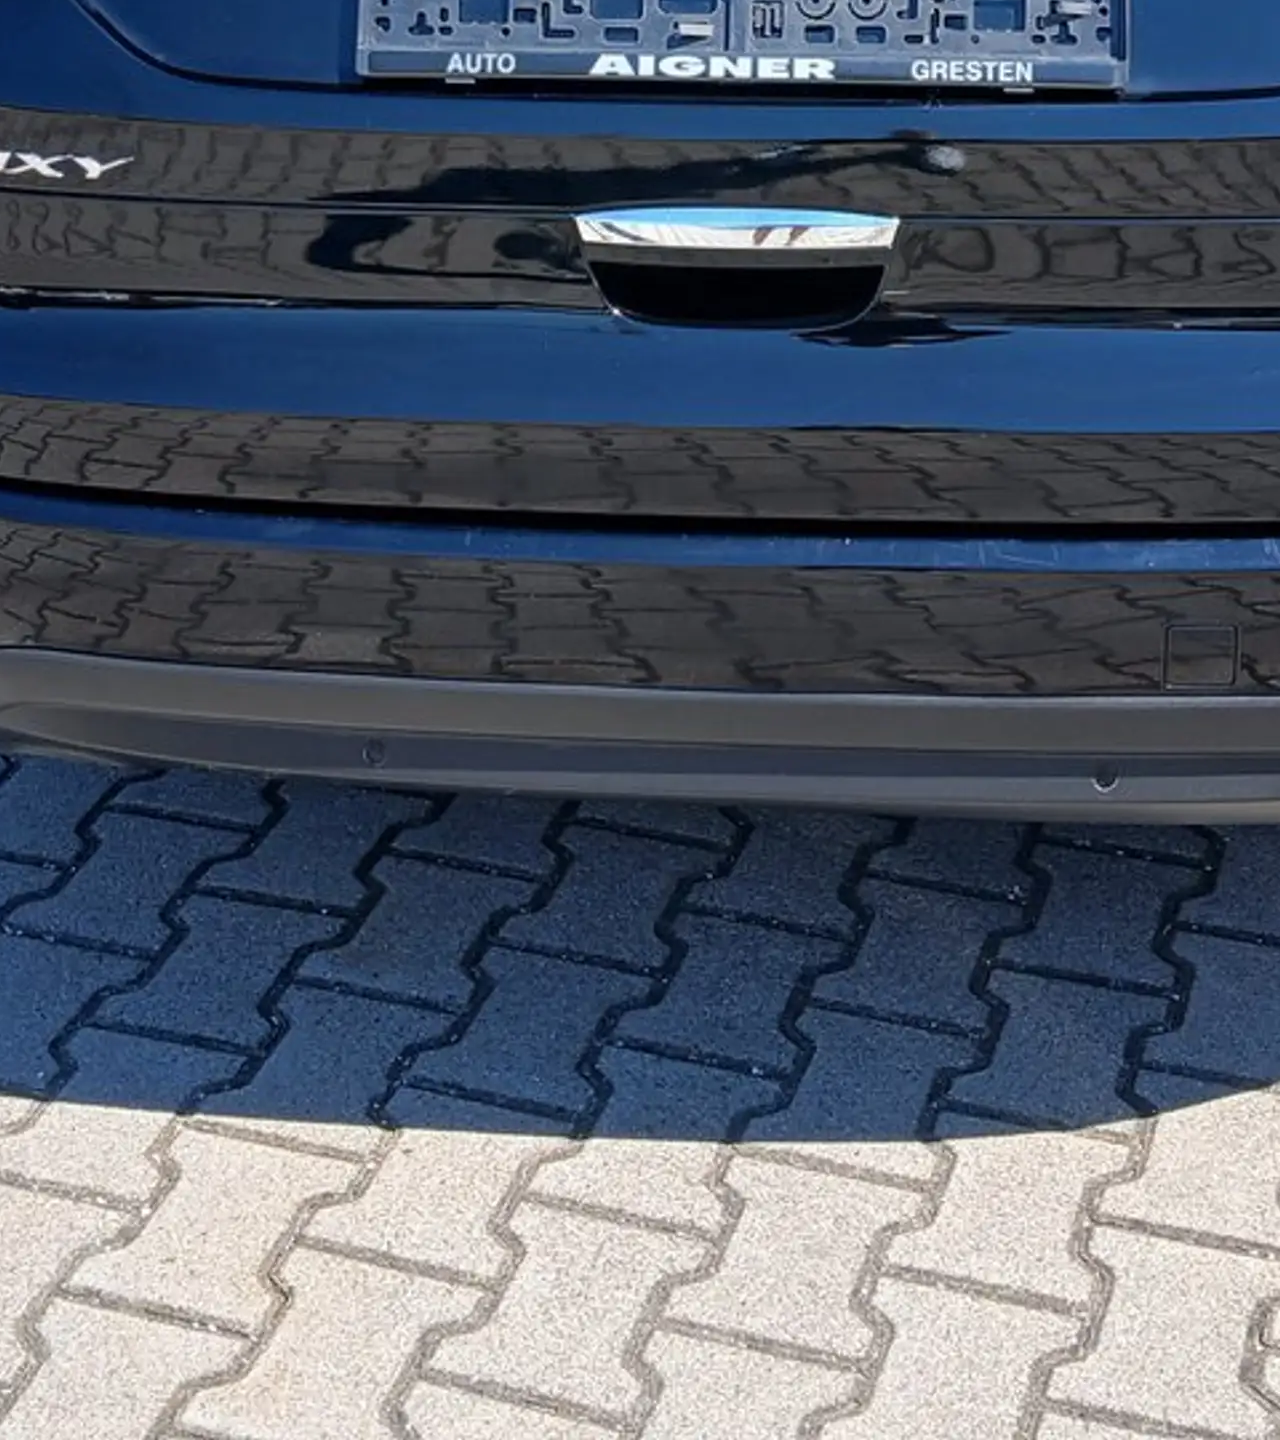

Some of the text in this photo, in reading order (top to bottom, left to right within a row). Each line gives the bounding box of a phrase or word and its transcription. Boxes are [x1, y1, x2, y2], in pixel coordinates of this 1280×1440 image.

[446, 53, 1034, 83] AUTO AIGNER GRESTEN
